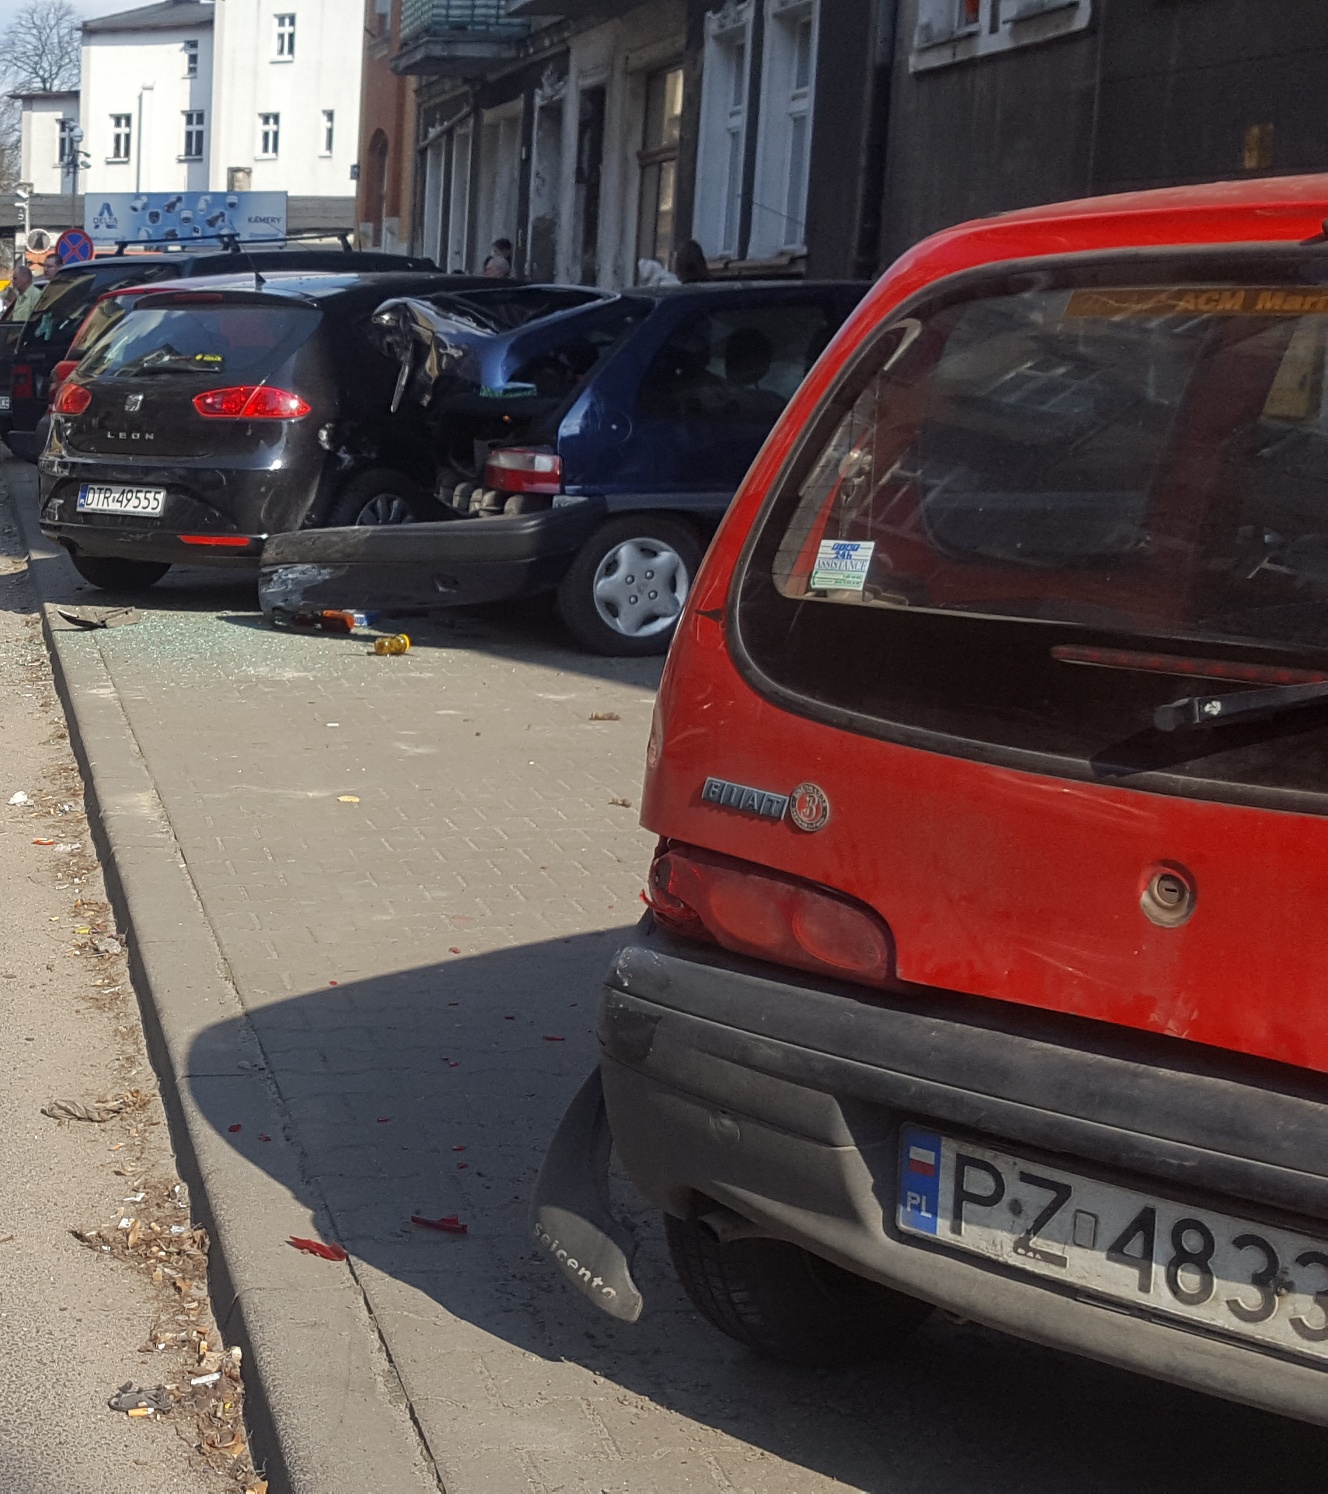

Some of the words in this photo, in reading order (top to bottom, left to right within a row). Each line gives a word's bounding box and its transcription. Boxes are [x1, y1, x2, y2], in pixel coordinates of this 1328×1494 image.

[1176, 289, 1245, 310] ACM
[107, 431, 154, 440] LEON
[86, 487, 113, 507] DTR
[116, 489, 162, 511] 49555
[816, 559, 867, 571] ASSISTANCE
[834, 551, 853, 560] 24h
[706, 779, 785, 817] FIAT
[905, 1190, 933, 1219] PL
[949, 1152, 1072, 1269] PZ
[1106, 1205, 1328, 1343] 4833
